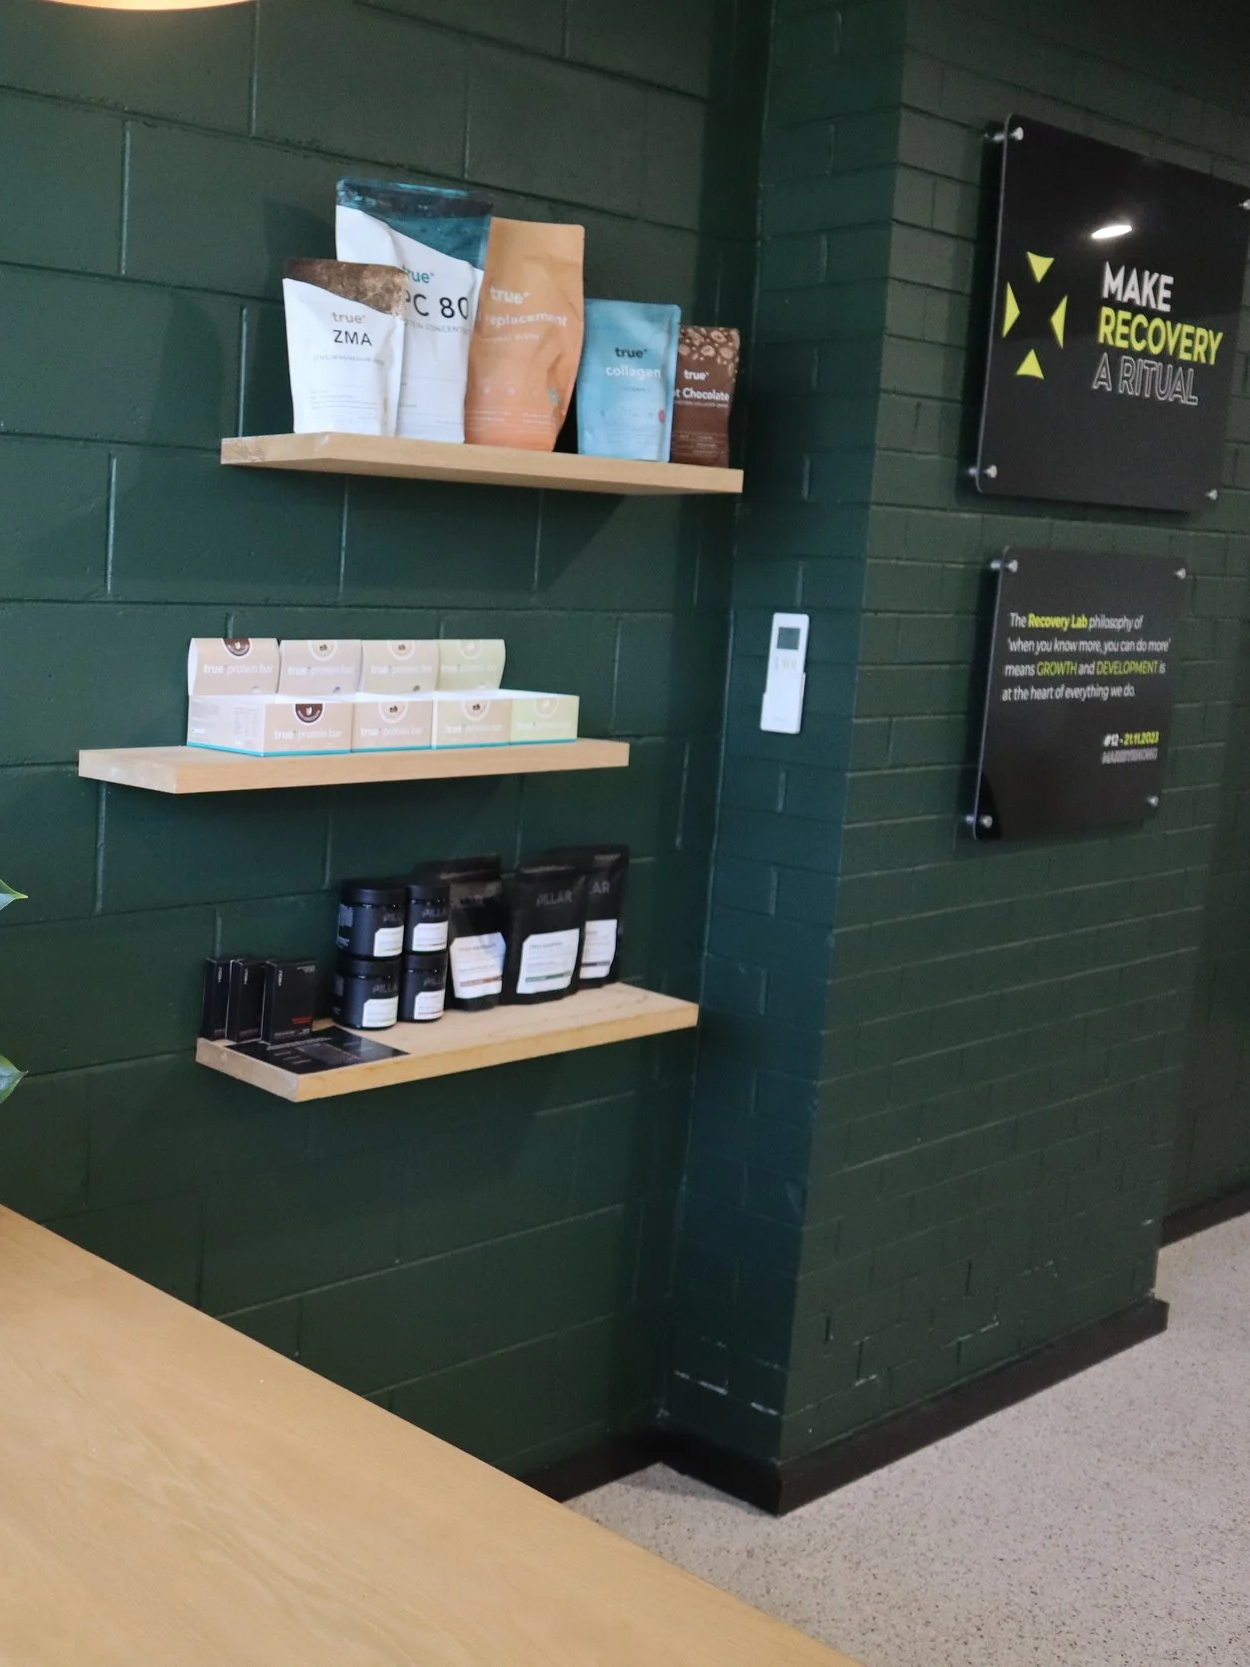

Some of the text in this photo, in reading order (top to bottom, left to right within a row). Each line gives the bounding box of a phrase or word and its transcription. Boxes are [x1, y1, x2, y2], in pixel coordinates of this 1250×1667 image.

[490, 286, 524, 305] true
[1103, 261, 1174, 313] MAKE
[439, 297, 469, 320] 80
[332, 312, 362, 324] true
[486, 312, 568, 329] replacement
[333, 329, 373, 346] ZMA
[1098, 306, 1224, 366] RECOVERY
[615, 348, 643, 358] true
[606, 365, 661, 381] collagen
[684, 370, 705, 381] true
[1092, 352, 1199, 406] A RITUAL
[683, 386, 730, 402] Chocolate
[1010, 612, 1144, 632] The Recovery Lab philosophy of
[1035, 639, 1053, 655] you
[1054, 637, 1078, 651] know
[1102, 640, 1119, 655] you
[1120, 640, 1135, 651] can
[1136, 638, 1147, 651] do
[203, 663, 224, 675] true
[1004, 660, 1167, 677] means GROWTH and DEVELOPMENT is
[1002, 688, 1013, 701] at
[1014, 685, 1030, 700] the
[1031, 686, 1054, 700] heart
[1055, 684, 1065, 699] of
[1065, 684, 1110, 702] everything
[1110, 686, 1123, 697] we
[274, 729, 294, 741] true
